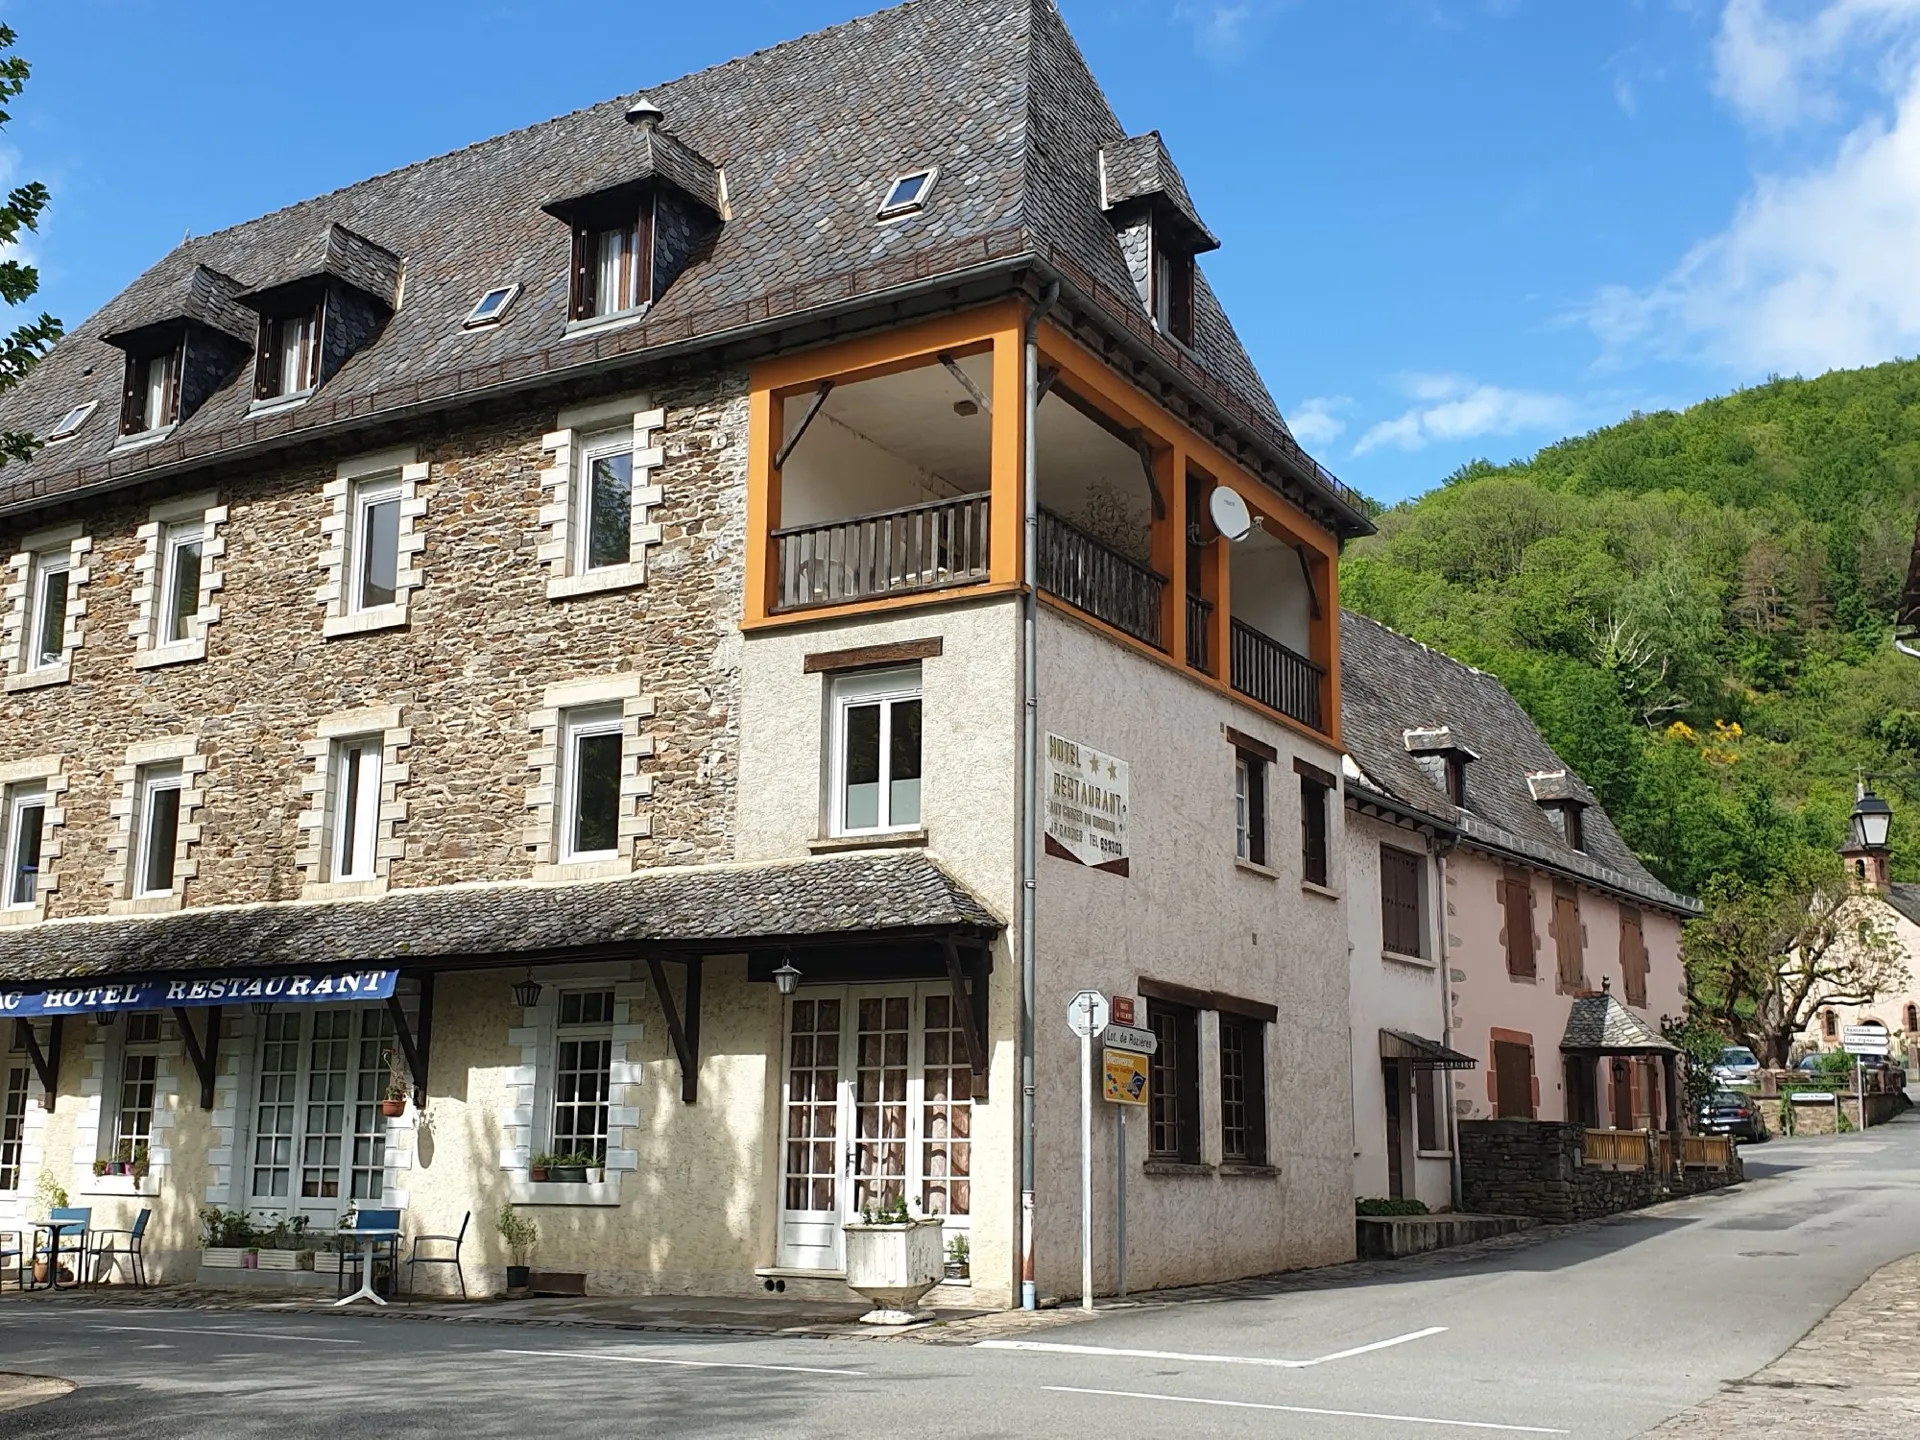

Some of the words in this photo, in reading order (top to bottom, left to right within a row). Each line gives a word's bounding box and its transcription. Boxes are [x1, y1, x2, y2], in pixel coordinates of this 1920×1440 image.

[1049, 735, 1082, 768] HOTEL
[1053, 772, 1121, 817] RESTAURANT
[1089, 833, 1099, 848] TEL
[166, 971, 386, 1000] RESTAURANT
[1119, 1032, 1128, 1044] de
[1129, 1033, 1152, 1049] Rozières
